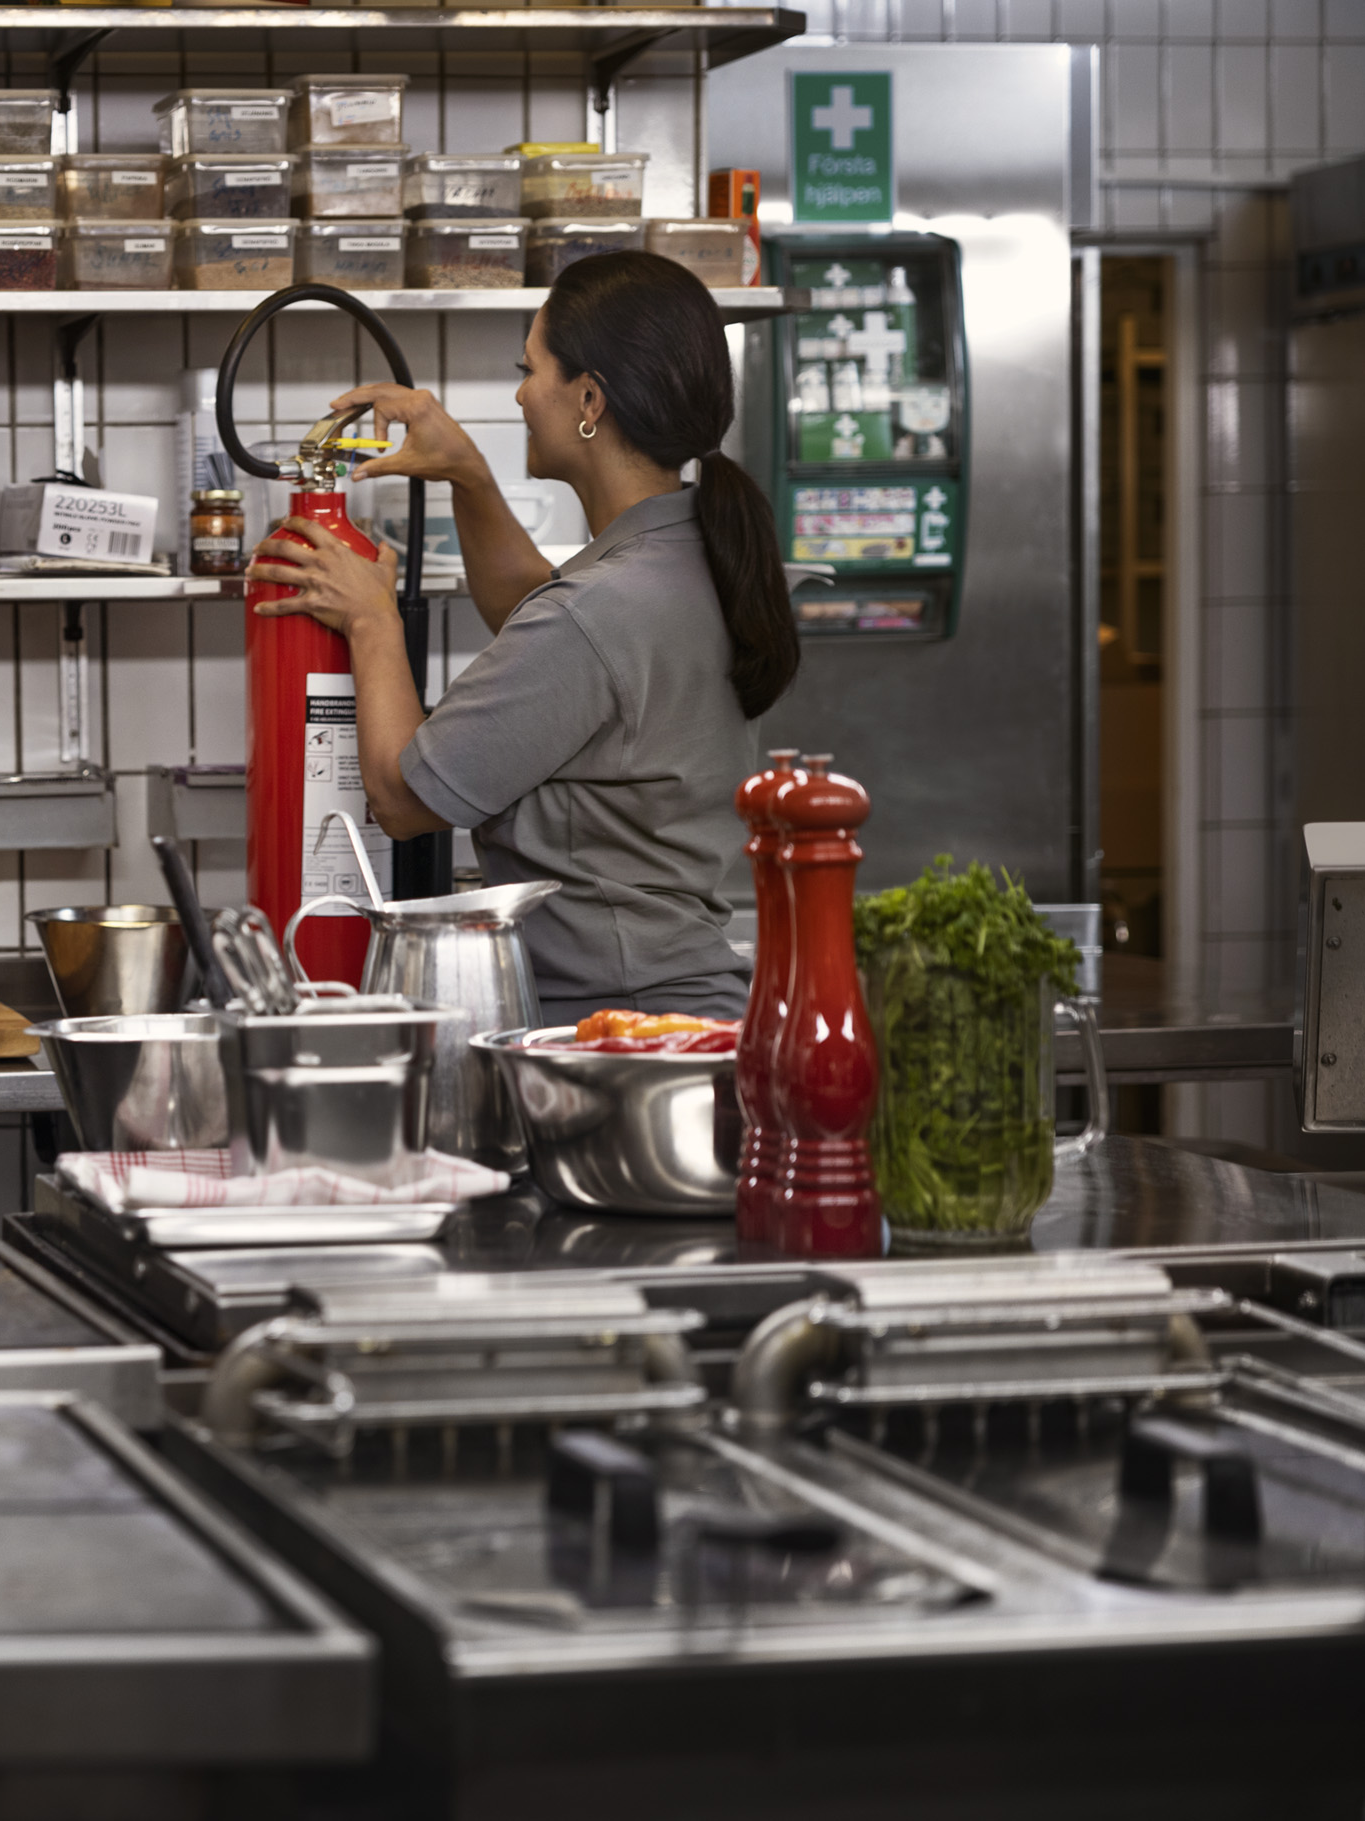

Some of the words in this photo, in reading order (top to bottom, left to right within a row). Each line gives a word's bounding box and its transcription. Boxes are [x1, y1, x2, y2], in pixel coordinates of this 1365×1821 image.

[808, 153, 876, 176] Första
[804, 182, 882, 210] hjälpen
[55, 494, 127, 518] 220253L
